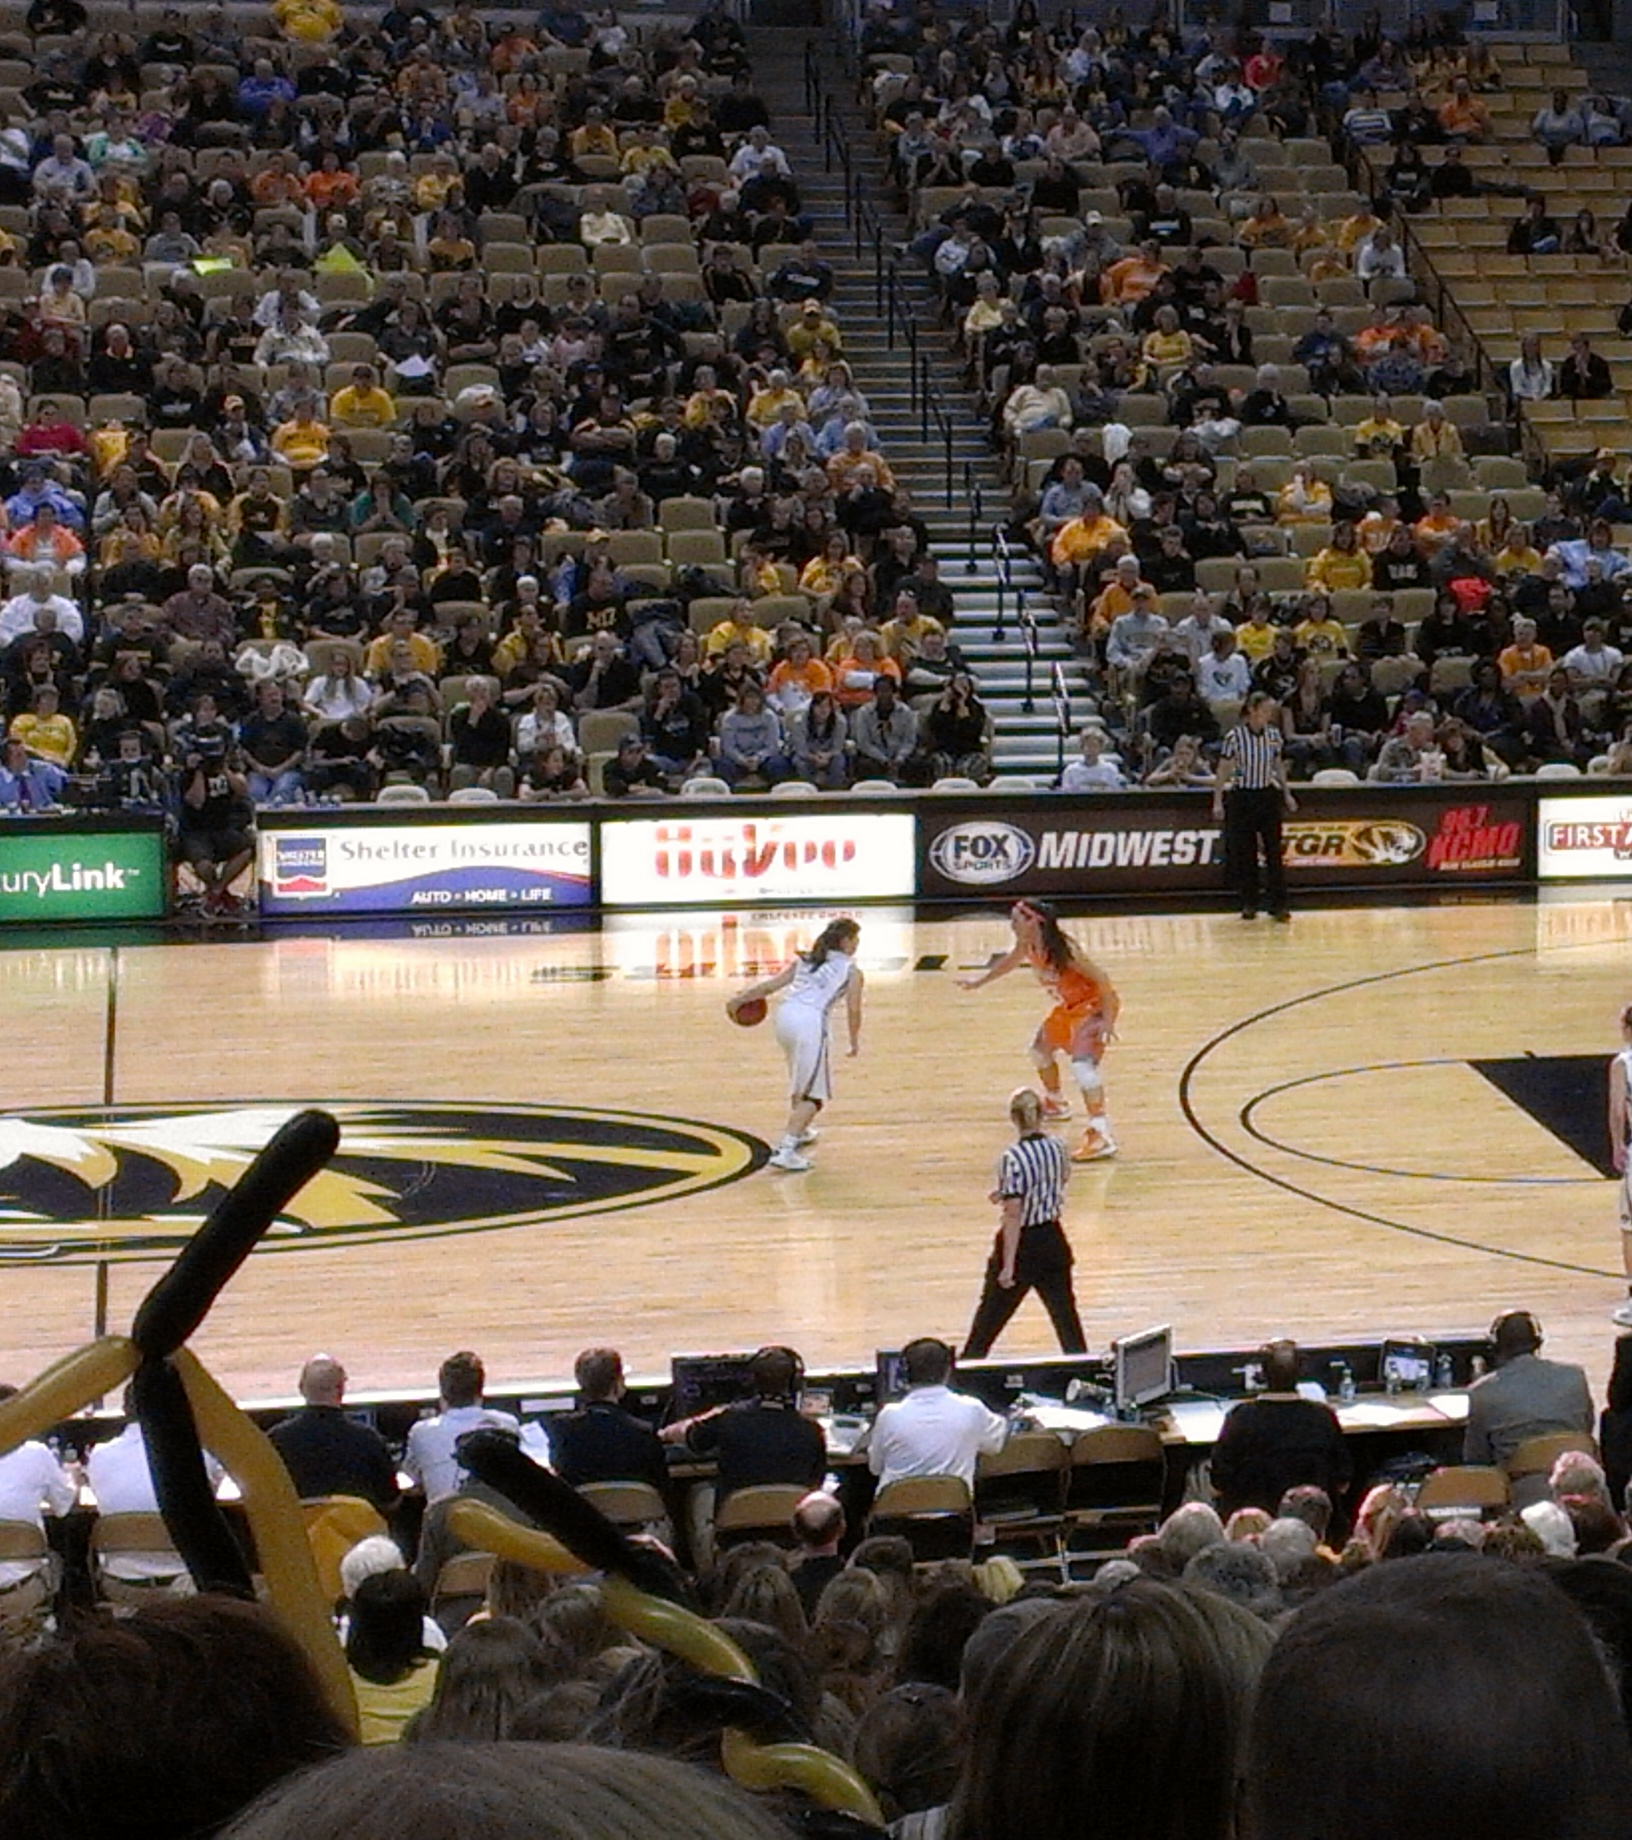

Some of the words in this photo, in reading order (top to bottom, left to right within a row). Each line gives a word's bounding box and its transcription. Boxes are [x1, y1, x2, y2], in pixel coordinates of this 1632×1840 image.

[954, 836, 1011, 858] FOX
[1552, 826, 1623, 847] FIRST
[340, 840, 441, 861] Shelter
[451, 838, 588, 858] Insurance
[1037, 830, 1221, 868] MIDWEST
[412, 890, 452, 904] AUTO
[521, 887, 552, 901] LIFE
